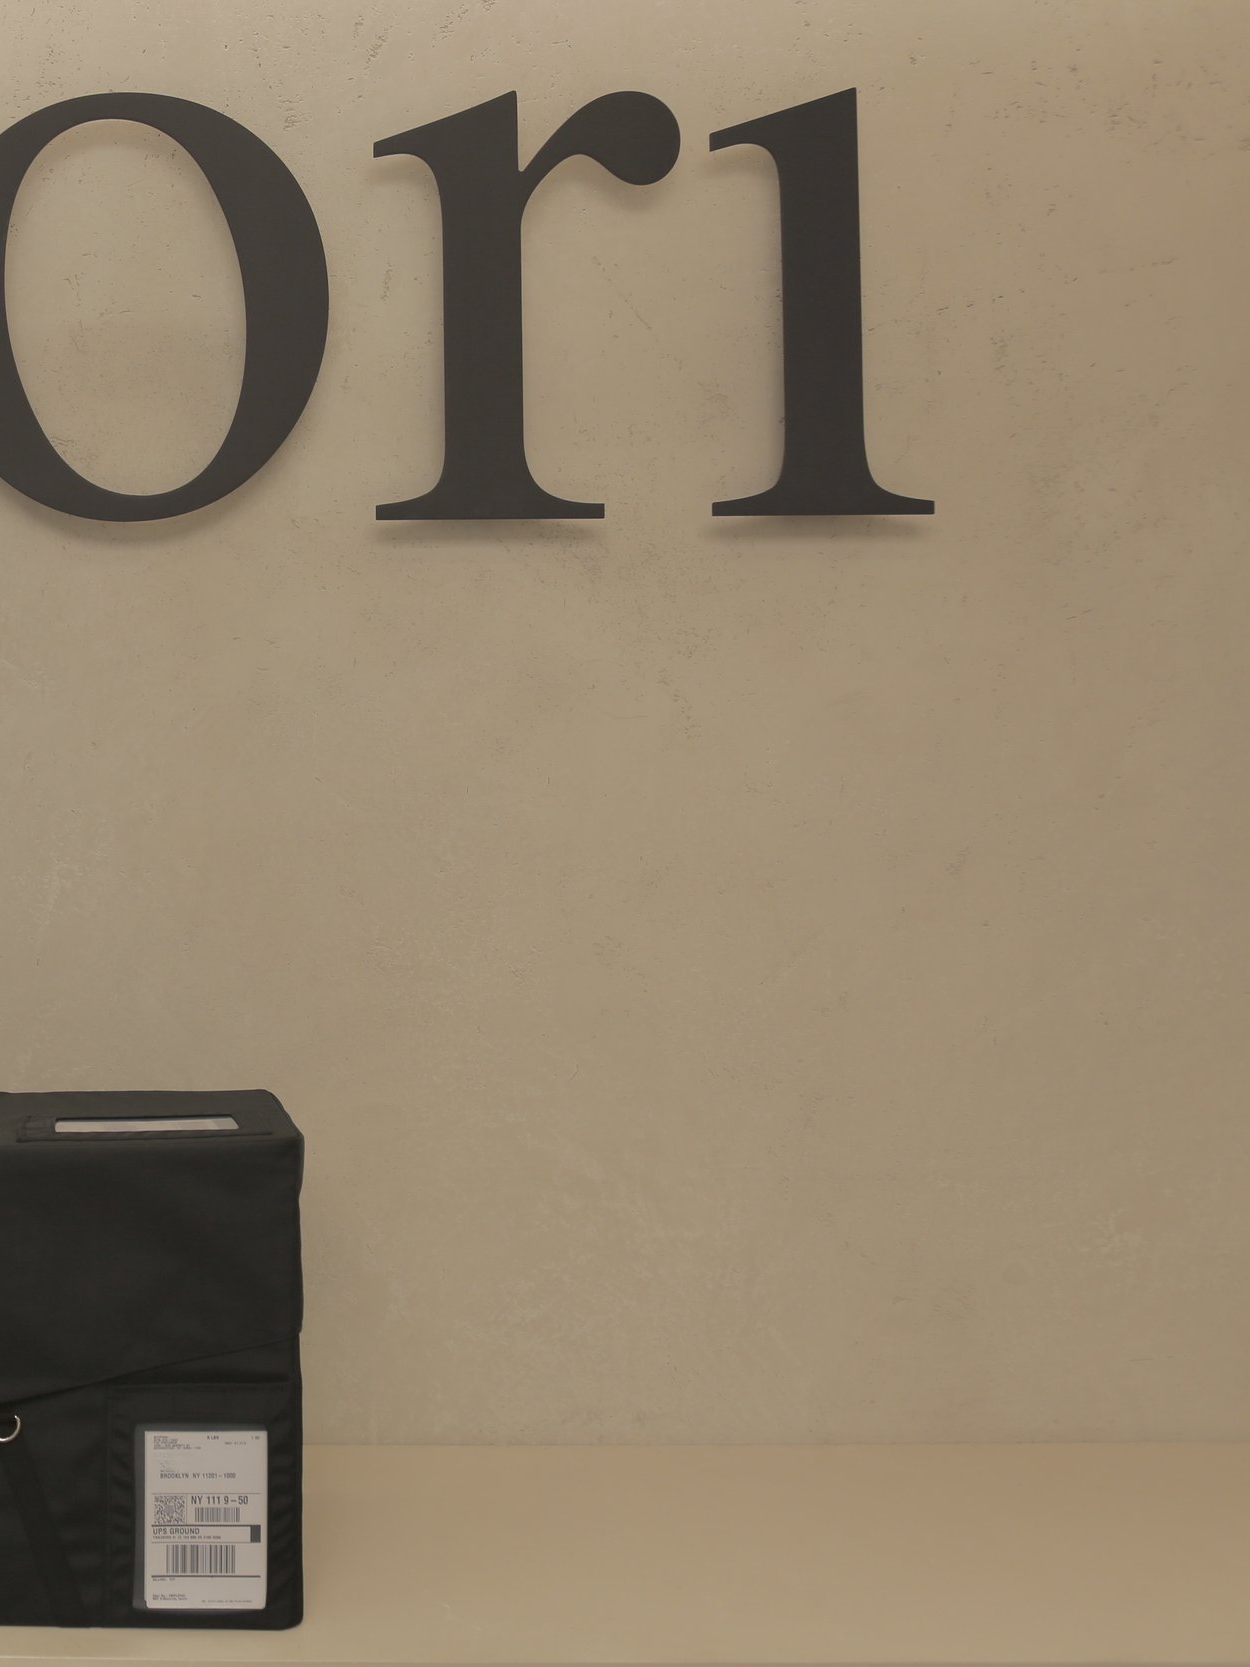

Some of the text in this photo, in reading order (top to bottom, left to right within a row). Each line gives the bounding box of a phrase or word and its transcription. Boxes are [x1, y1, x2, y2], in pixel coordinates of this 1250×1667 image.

[160, 1472, 189, 1480] BROOKLYN
[192, 1472, 200, 1480] NY
[191, 1495, 204, 1505] NY
[206, 1495, 221, 1505] 111
[152, 1527, 200, 1535] UPS GROUND
